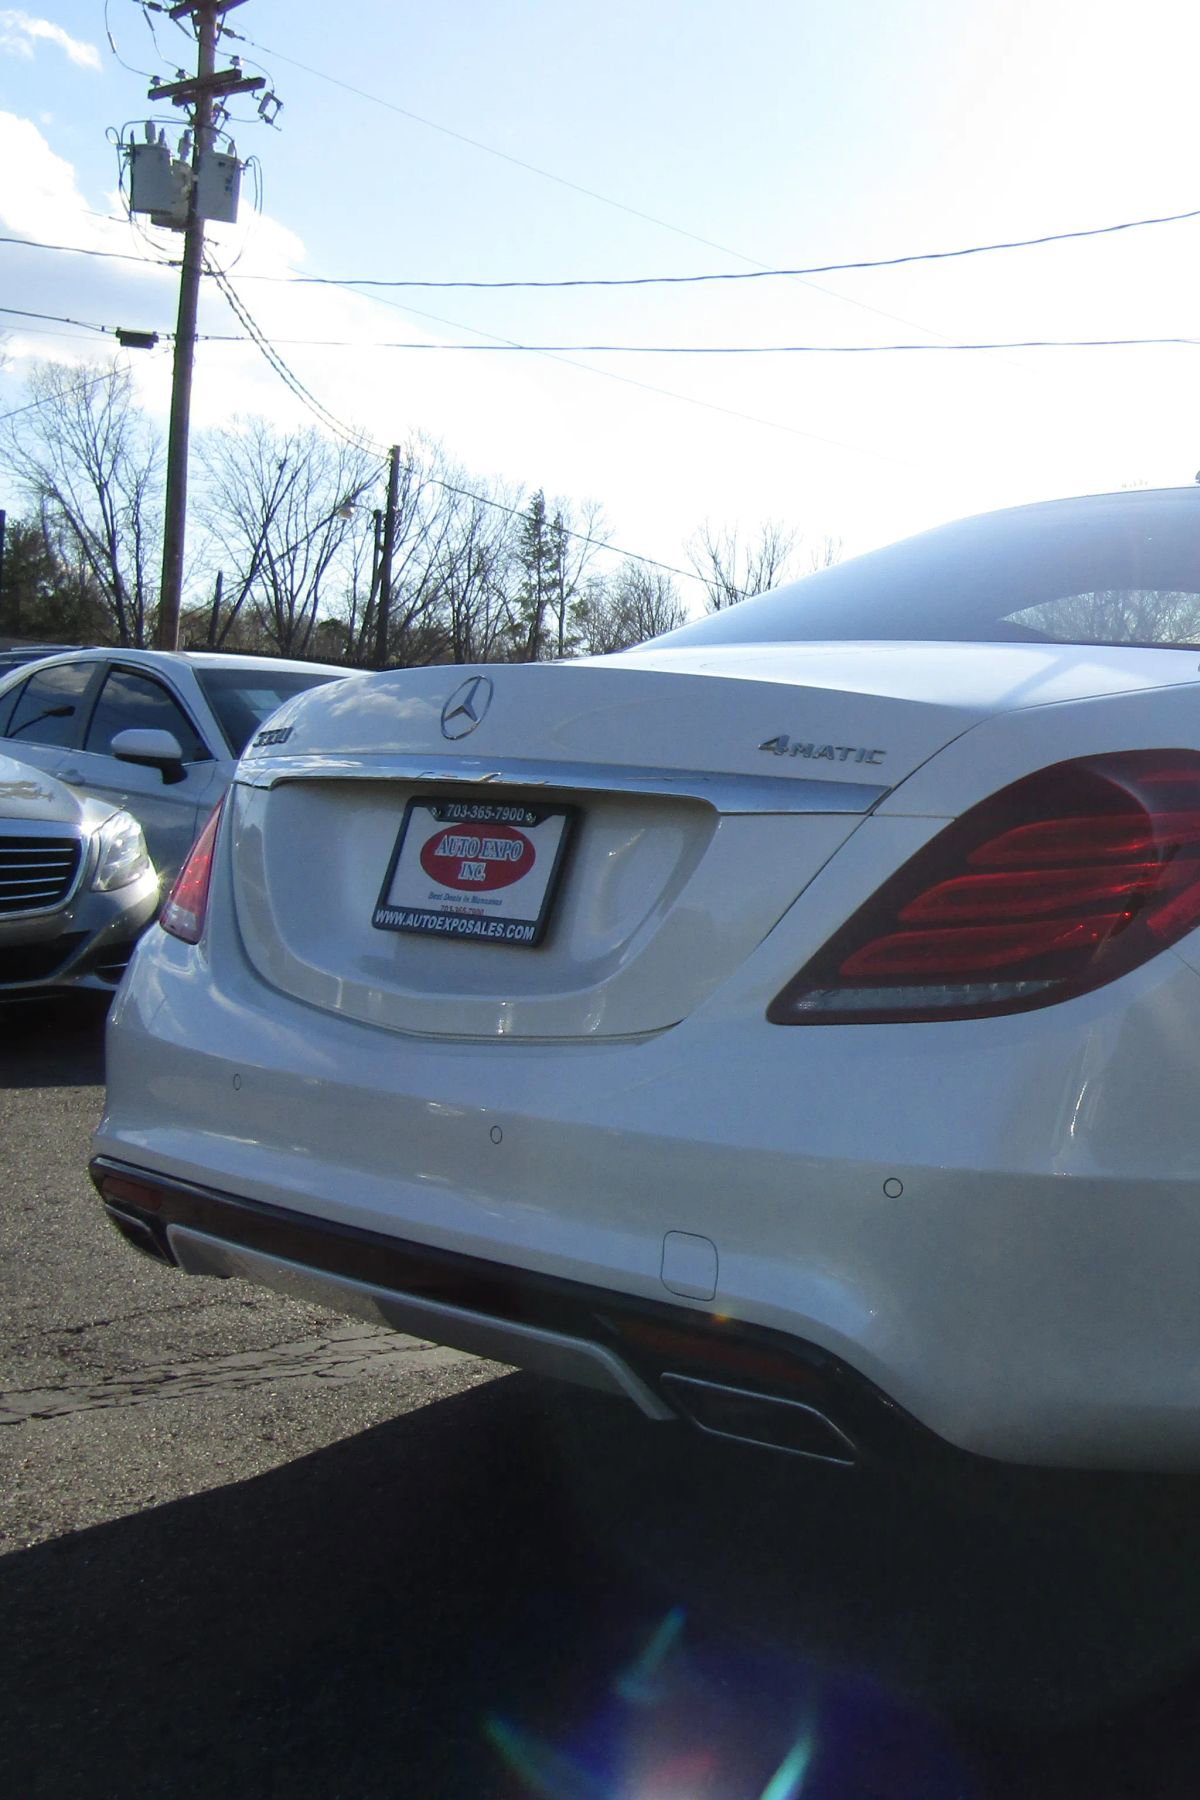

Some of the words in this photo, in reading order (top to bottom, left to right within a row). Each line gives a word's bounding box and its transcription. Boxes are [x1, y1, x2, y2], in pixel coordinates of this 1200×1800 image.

[758, 735, 887, 765] 4MATIC
[446, 804, 525, 821] 703-365-7900
[434, 834, 480, 858] AUTO
[479, 838, 524, 862] EXPO
[458, 861, 487, 882] INC.
[375, 909, 535, 940] WWW.AUTOEXPOSALES.COM
